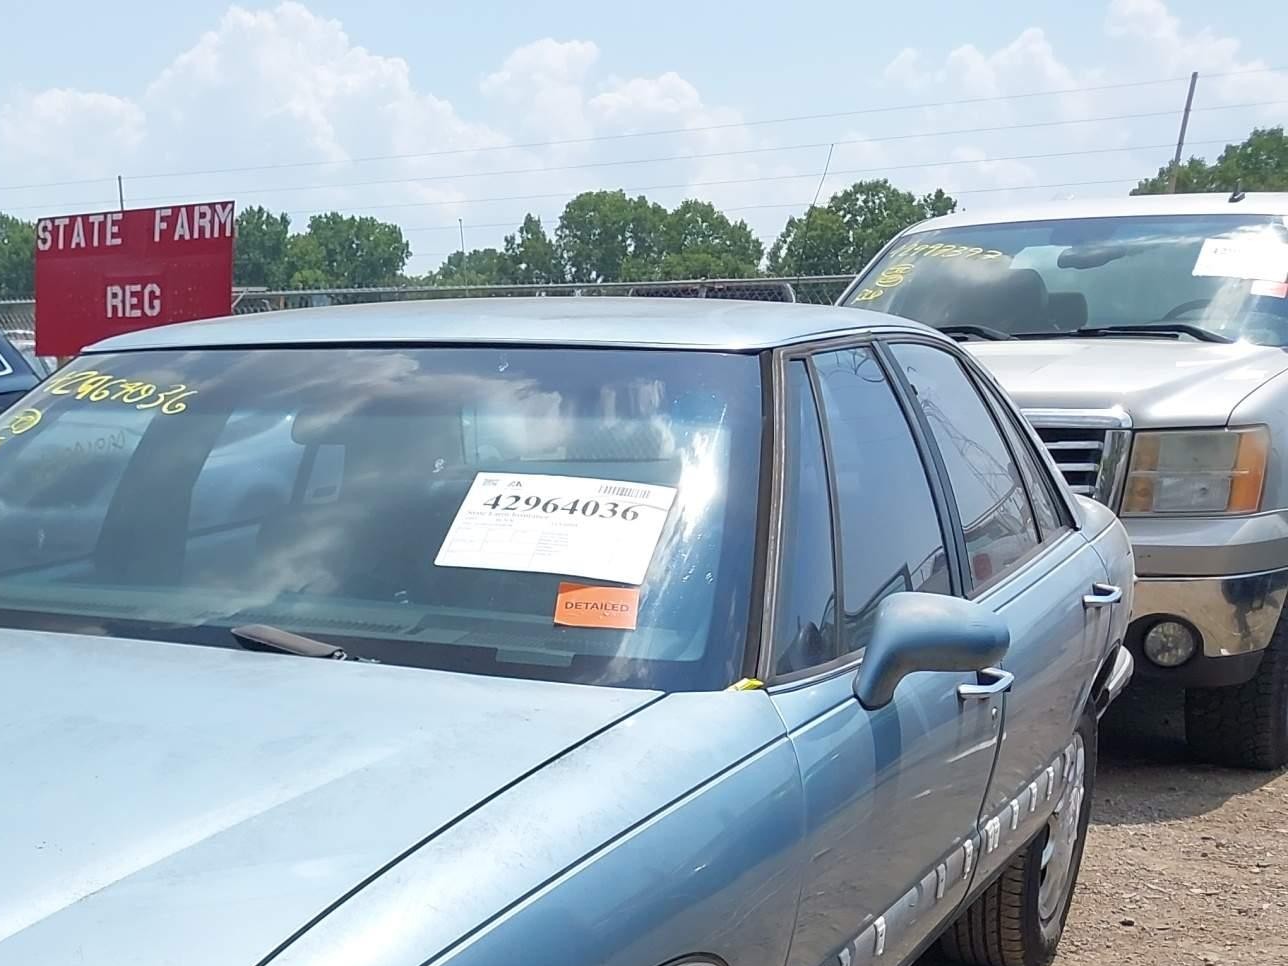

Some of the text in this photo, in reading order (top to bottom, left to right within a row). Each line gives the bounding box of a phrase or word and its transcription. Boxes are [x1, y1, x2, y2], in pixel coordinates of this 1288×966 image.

[37, 203, 233, 251] STATE FARM
[106, 283, 161, 318] REG
[483, 493, 639, 521] 42964036
[564, 601, 629, 612] DETAILED
